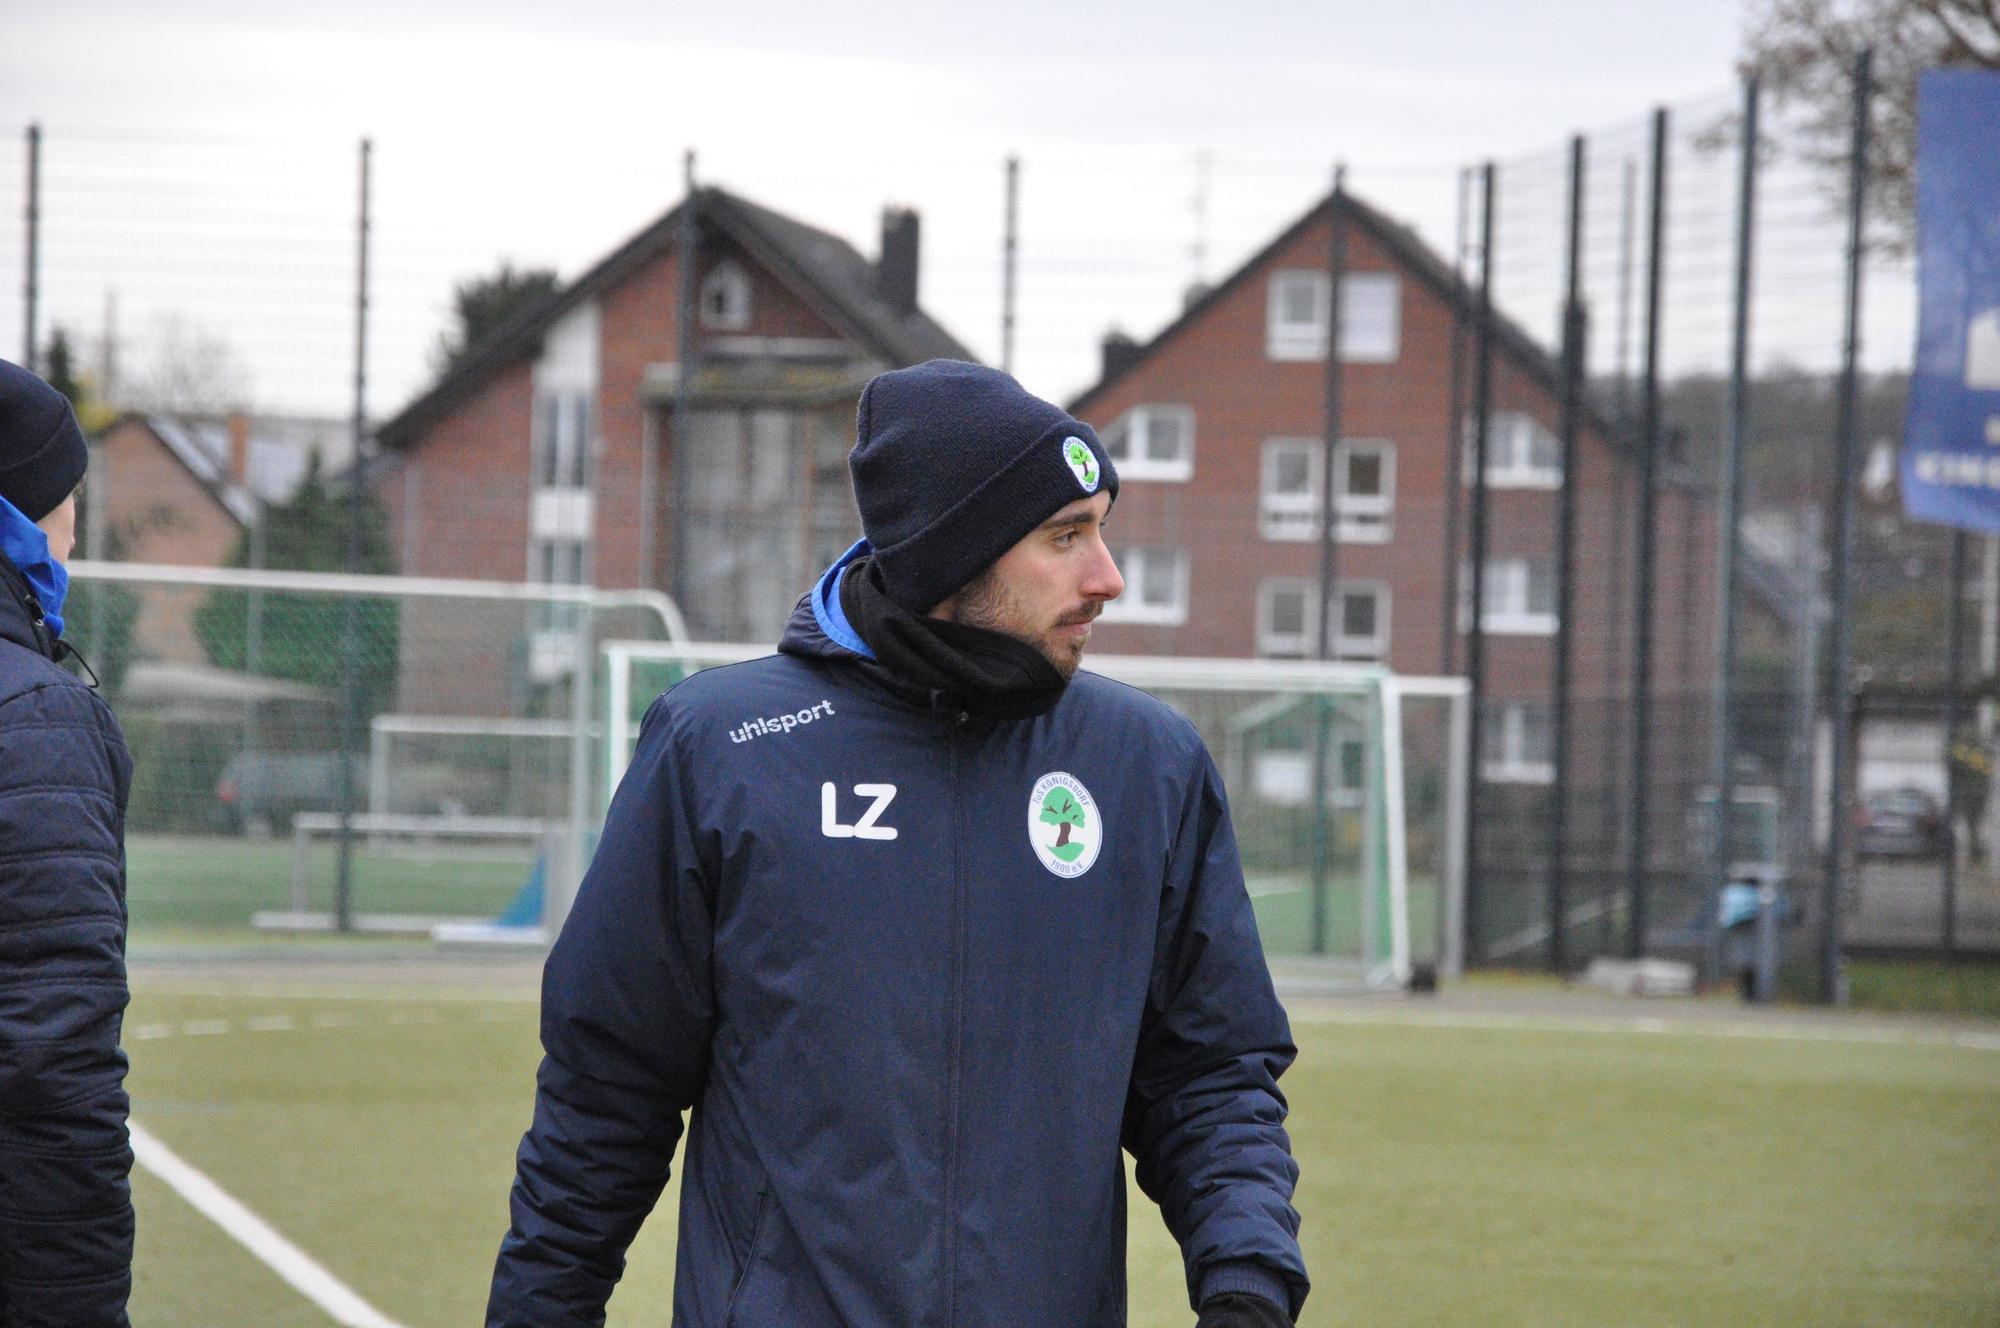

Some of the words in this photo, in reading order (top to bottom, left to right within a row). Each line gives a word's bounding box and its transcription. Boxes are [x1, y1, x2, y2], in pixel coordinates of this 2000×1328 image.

[729, 700, 836, 744] uhlsport
[821, 781, 899, 841] LZ
[1051, 860, 1070, 873] 1900
